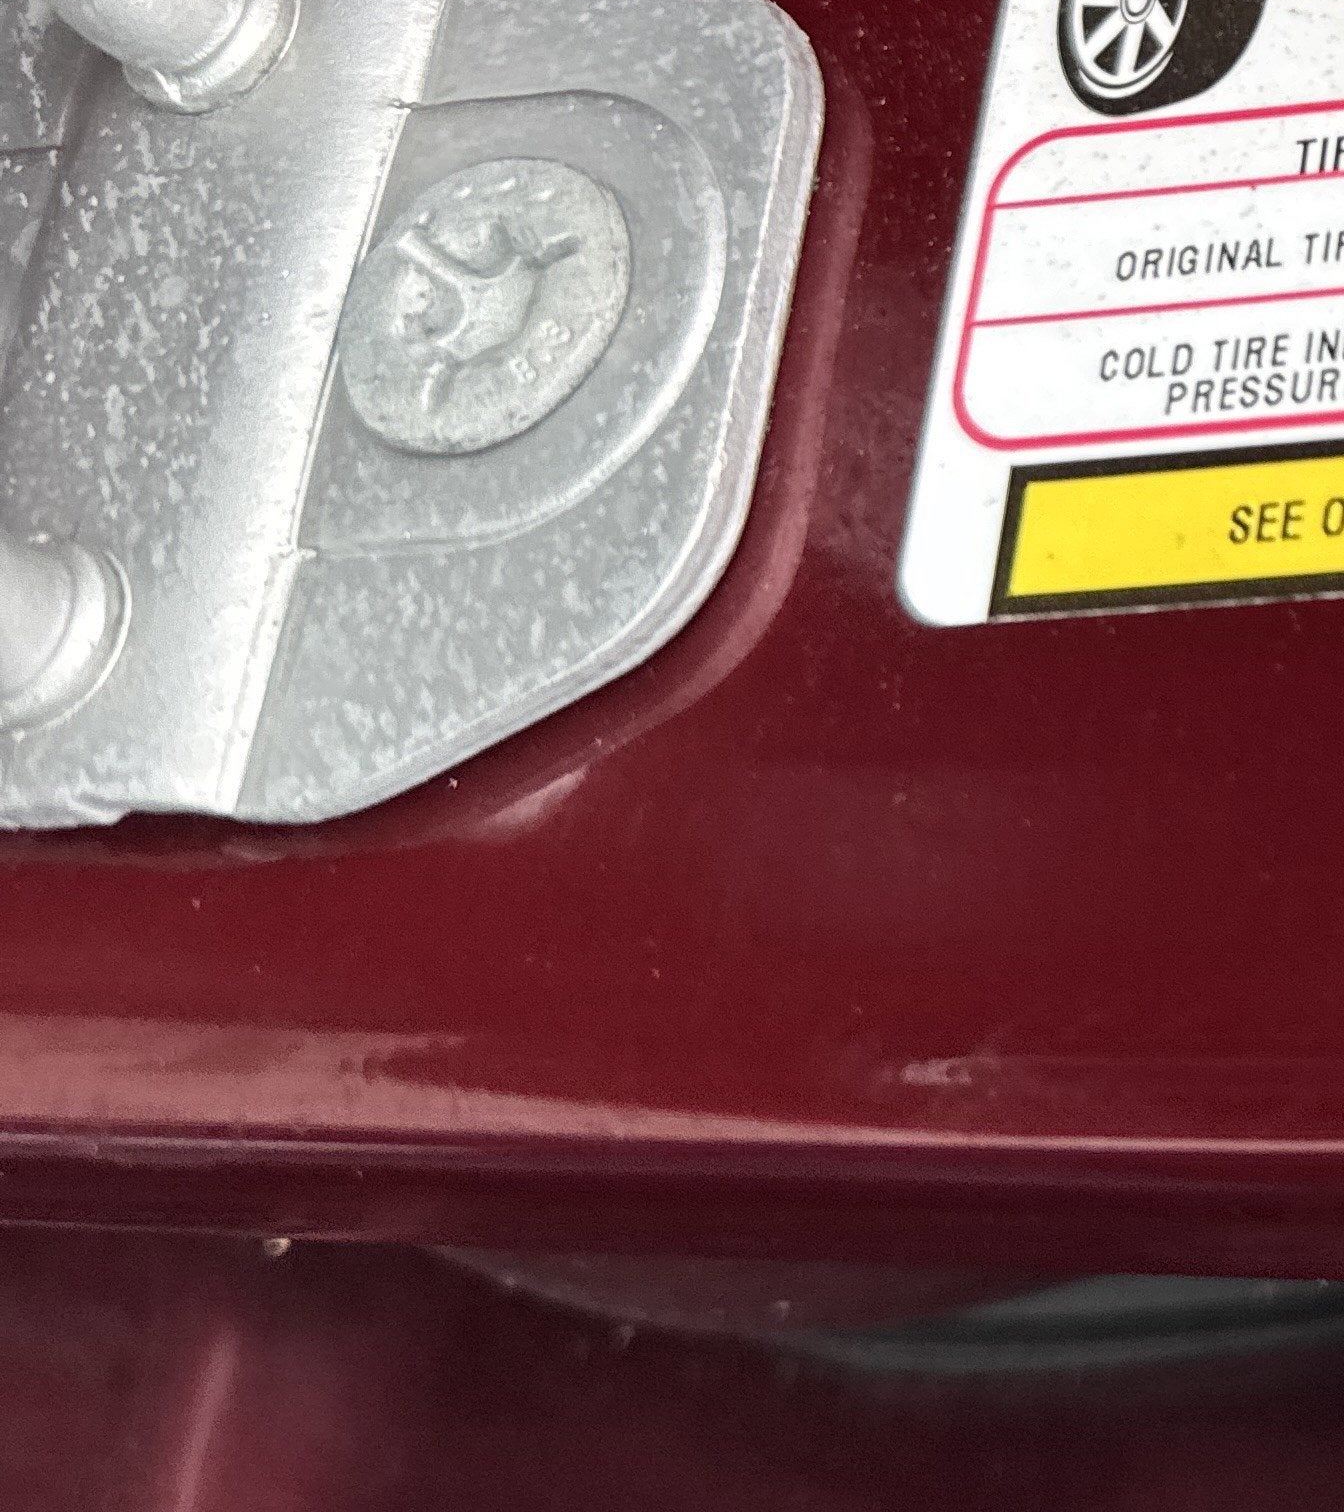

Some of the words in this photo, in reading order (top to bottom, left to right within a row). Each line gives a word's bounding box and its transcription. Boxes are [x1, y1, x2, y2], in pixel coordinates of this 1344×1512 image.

[1115, 240, 1282, 282] ORIGINAL
[1099, 340, 1194, 383] COLD
[1211, 333, 1290, 370] TIRE
[1228, 500, 1305, 546] SEE
